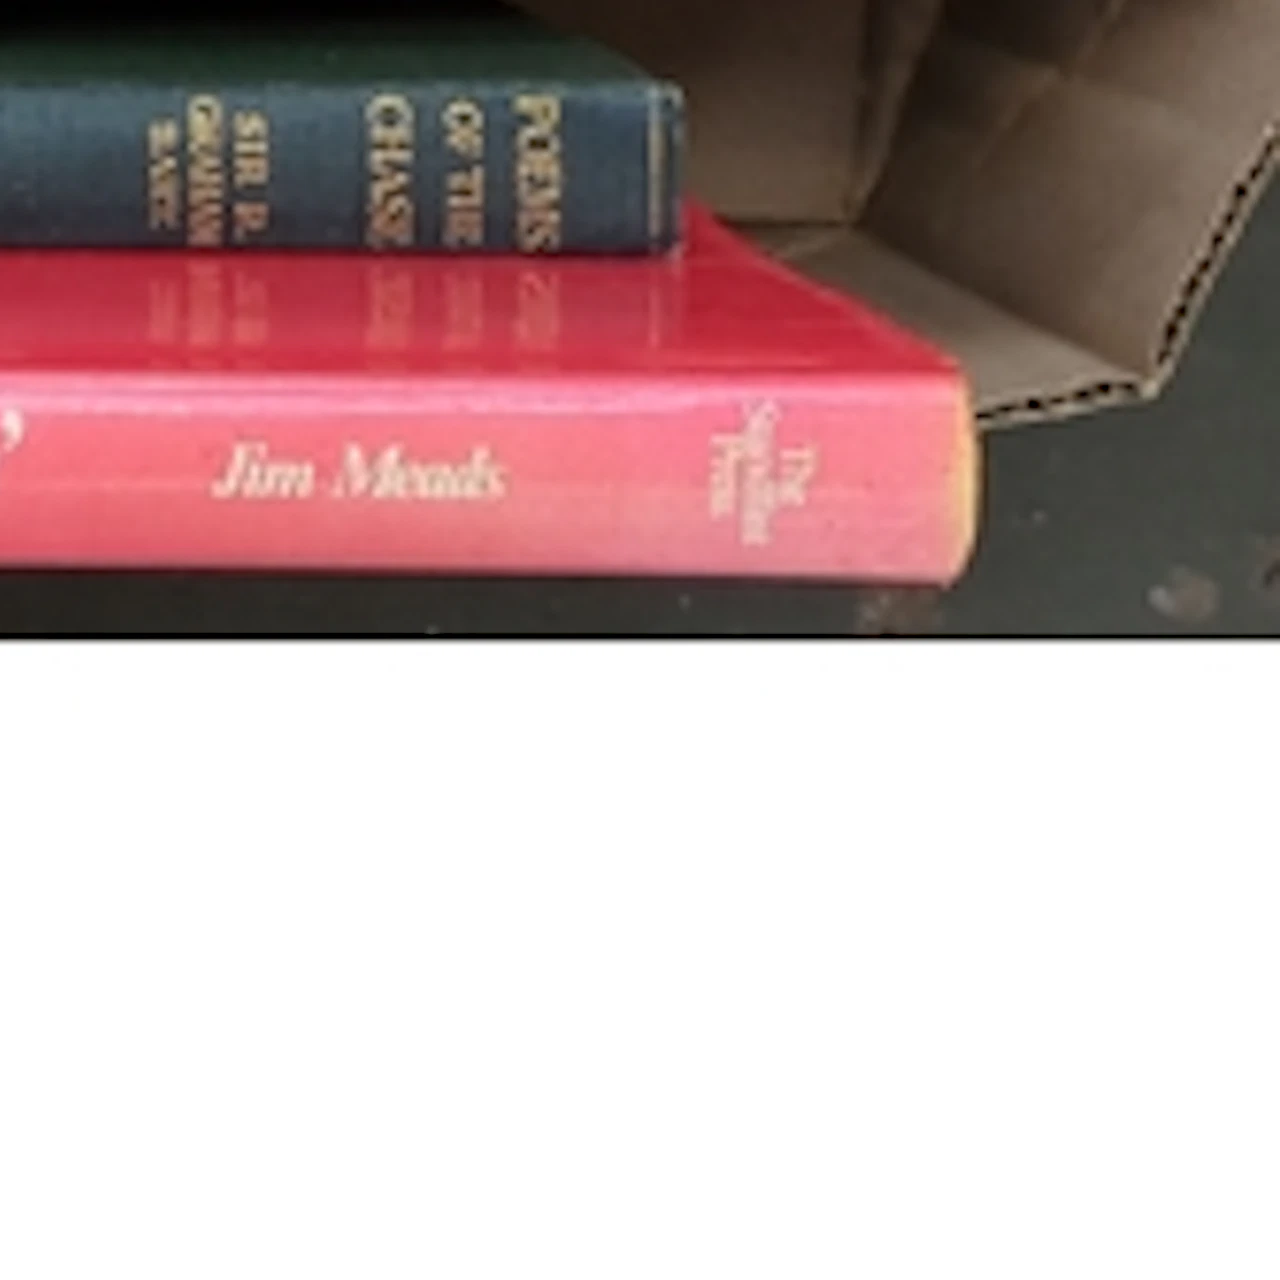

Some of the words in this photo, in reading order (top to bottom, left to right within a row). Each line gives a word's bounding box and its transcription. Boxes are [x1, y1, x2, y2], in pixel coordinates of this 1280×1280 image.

[232, 109, 270, 187] SIR
[441, 97, 486, 157] OF
[361, 91, 417, 252] CHASE
[443, 163, 486, 249] THE
[511, 91, 563, 254] POEMS
[210, 440, 316, 500] Jim
[331, 440, 507, 503] Meads
